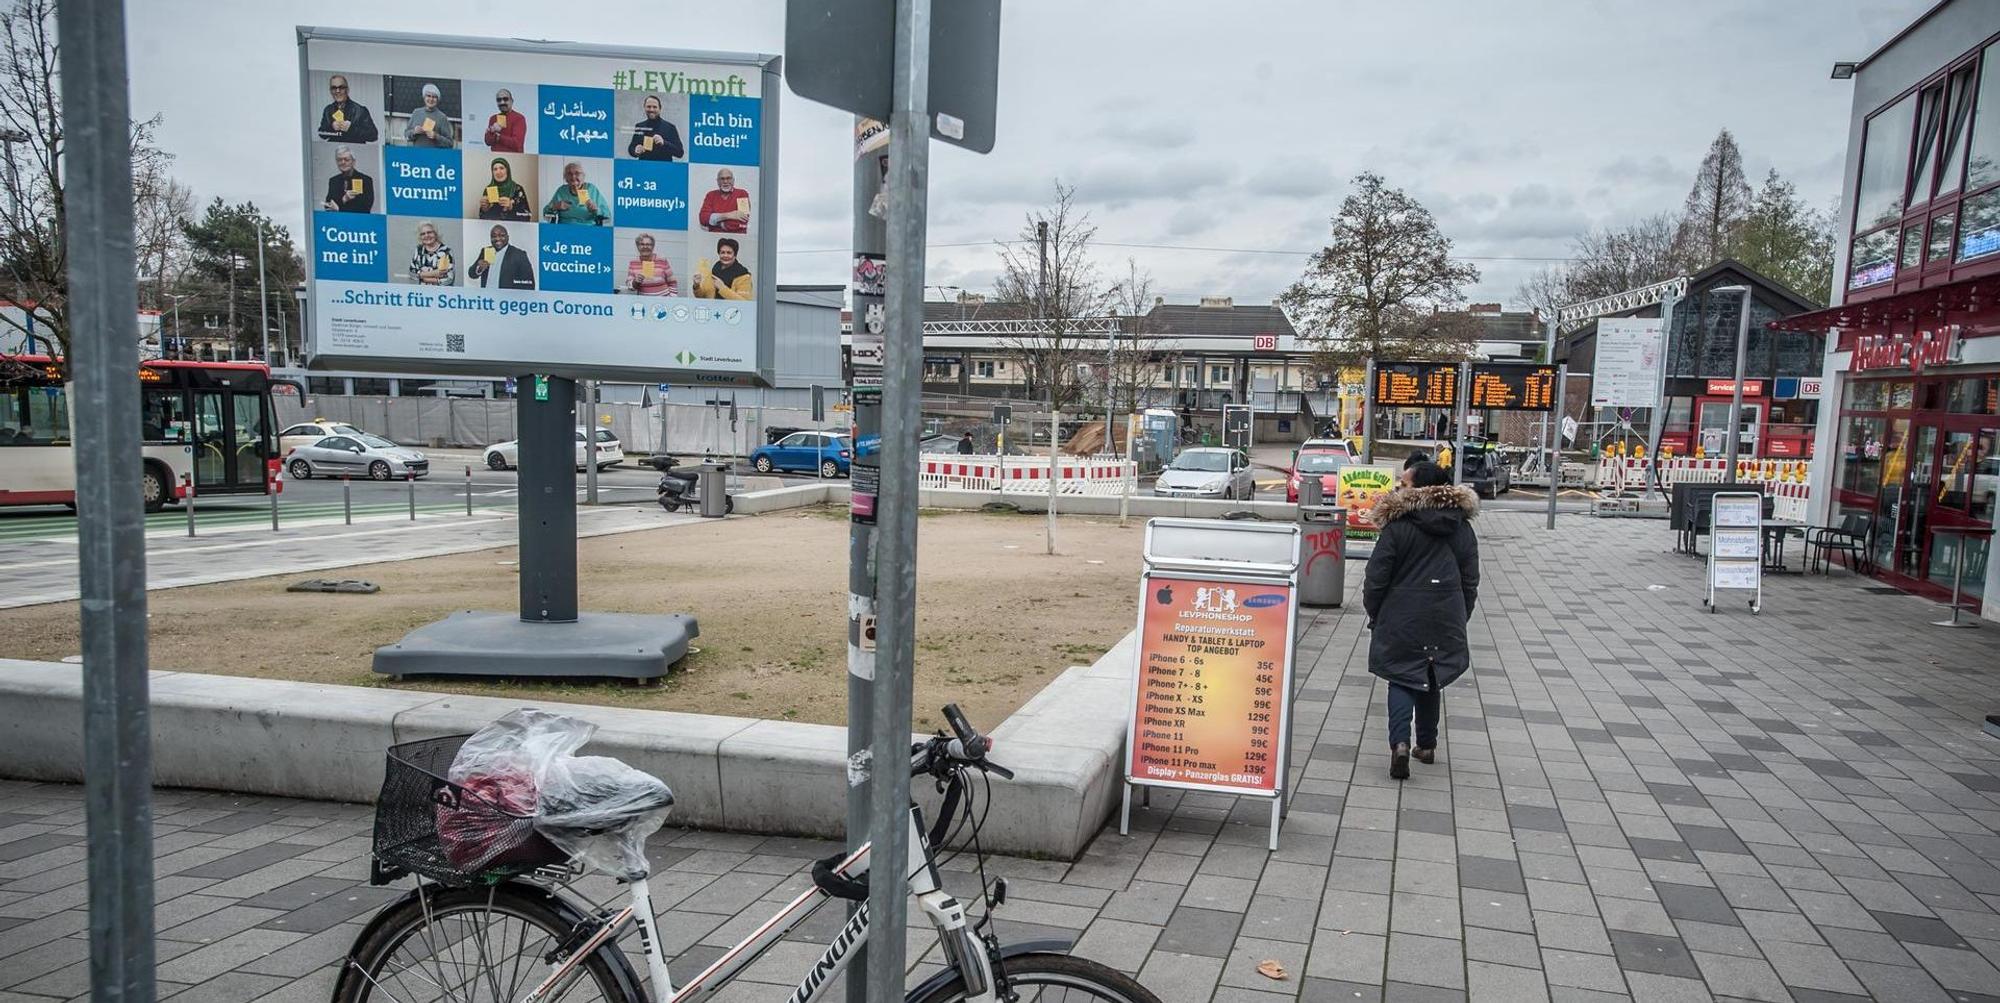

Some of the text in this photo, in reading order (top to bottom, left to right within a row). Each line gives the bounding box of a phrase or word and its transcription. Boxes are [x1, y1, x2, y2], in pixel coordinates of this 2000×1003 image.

[612, 70, 747, 102] #LEVimpft
[729, 113, 753, 128] bin
[435, 164, 456, 181] de
[617, 177, 633, 190] «Я
[643, 181, 657, 191] за
[617, 196, 686, 211] прививку!»
[552, 242, 567, 255] Je
[571, 244, 592, 255] me
[322, 252, 348, 263] me
[407, 292, 434, 308] für
[438, 294, 495, 311] Schritt
[499, 300, 549, 316] gegen
[553, 300, 613, 316] Corona
[1257, 337, 1274, 349] DB
[1804, 383, 1820, 393] DB
[1179, 611, 1253, 622] LEVPHONESHOP
[1175, 623, 1255, 637] Reparaturwerkstatt
[1163, 634, 1188, 644] HANDY
[1198, 637, 1226, 646] TABLET
[1235, 639, 1265, 648] LAPTOP
[1187, 645, 1239, 656] TOP ANGEBOT
[1150, 653, 1178, 664] iPhone
[1179, 655, 1185, 664] 6
[1194, 657, 1204, 665] 6s
[1257, 662, 1274, 671] 35€
[1148, 665, 1177, 676] iPhone
[1178, 668, 1184, 676] 7
[1194, 670, 1201, 678] 8
[1256, 675, 1273, 683] 45€
[1147, 678, 1175, 689] iPhone
[1195, 682, 1201, 691] 8
[1255, 688, 1272, 696] 59€
[1146, 691, 1174, 702] iPhone
[1175, 694, 1182, 702] X
[1192, 695, 1203, 704] XS
[1254, 701, 1271, 709] 99€
[1145, 704, 1270, 722] iPhone XS Max 129€
[1144, 717, 1269, 735] iPhone XR 99€
[1143, 730, 1268, 748] iPhone 11 99€
[1142, 742, 1267, 761] iPhone 11 Pro 129€
[1141, 755, 1266, 774] iPhone 11 Pro max 139€
[1148, 766, 1176, 778] Display
[1185, 770, 1229, 782] Panzerglas
[1231, 773, 1262, 785] GRATIS!
